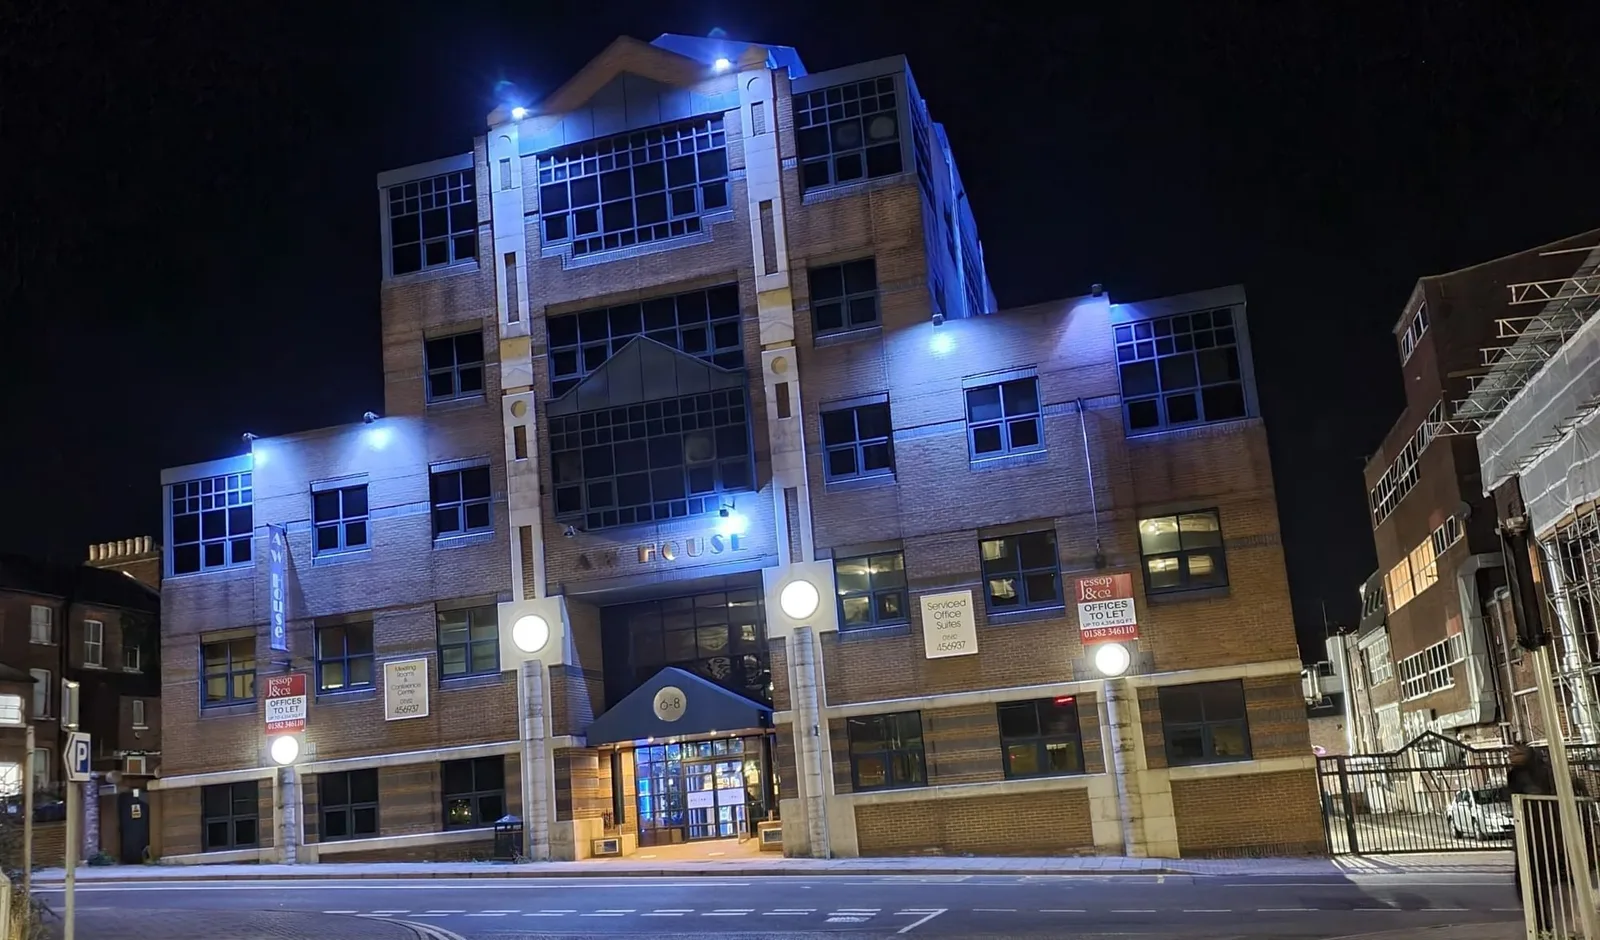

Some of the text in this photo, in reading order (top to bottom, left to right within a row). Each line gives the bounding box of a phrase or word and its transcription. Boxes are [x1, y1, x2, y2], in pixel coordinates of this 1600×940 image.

[637, 533, 748, 563] HOUSE
[1080, 577, 1112, 600] Jessop
[927, 599, 967, 611] Serviced
[1084, 600, 1128, 612] OFFICES
[933, 610, 962, 620] Office
[1089, 609, 1125, 620] TO LET
[936, 620, 962, 630] Suites
[1084, 626, 1135, 638] 01582 346110
[936, 641, 966, 651] 456937
[268, 677, 292, 697] Jessop
[270, 697, 302, 707] OFFICES
[660, 697, 680, 710] 6-8
[285, 705, 299, 713] LET
[394, 704, 419, 714] 456937
[77, 742, 88, 771] P
